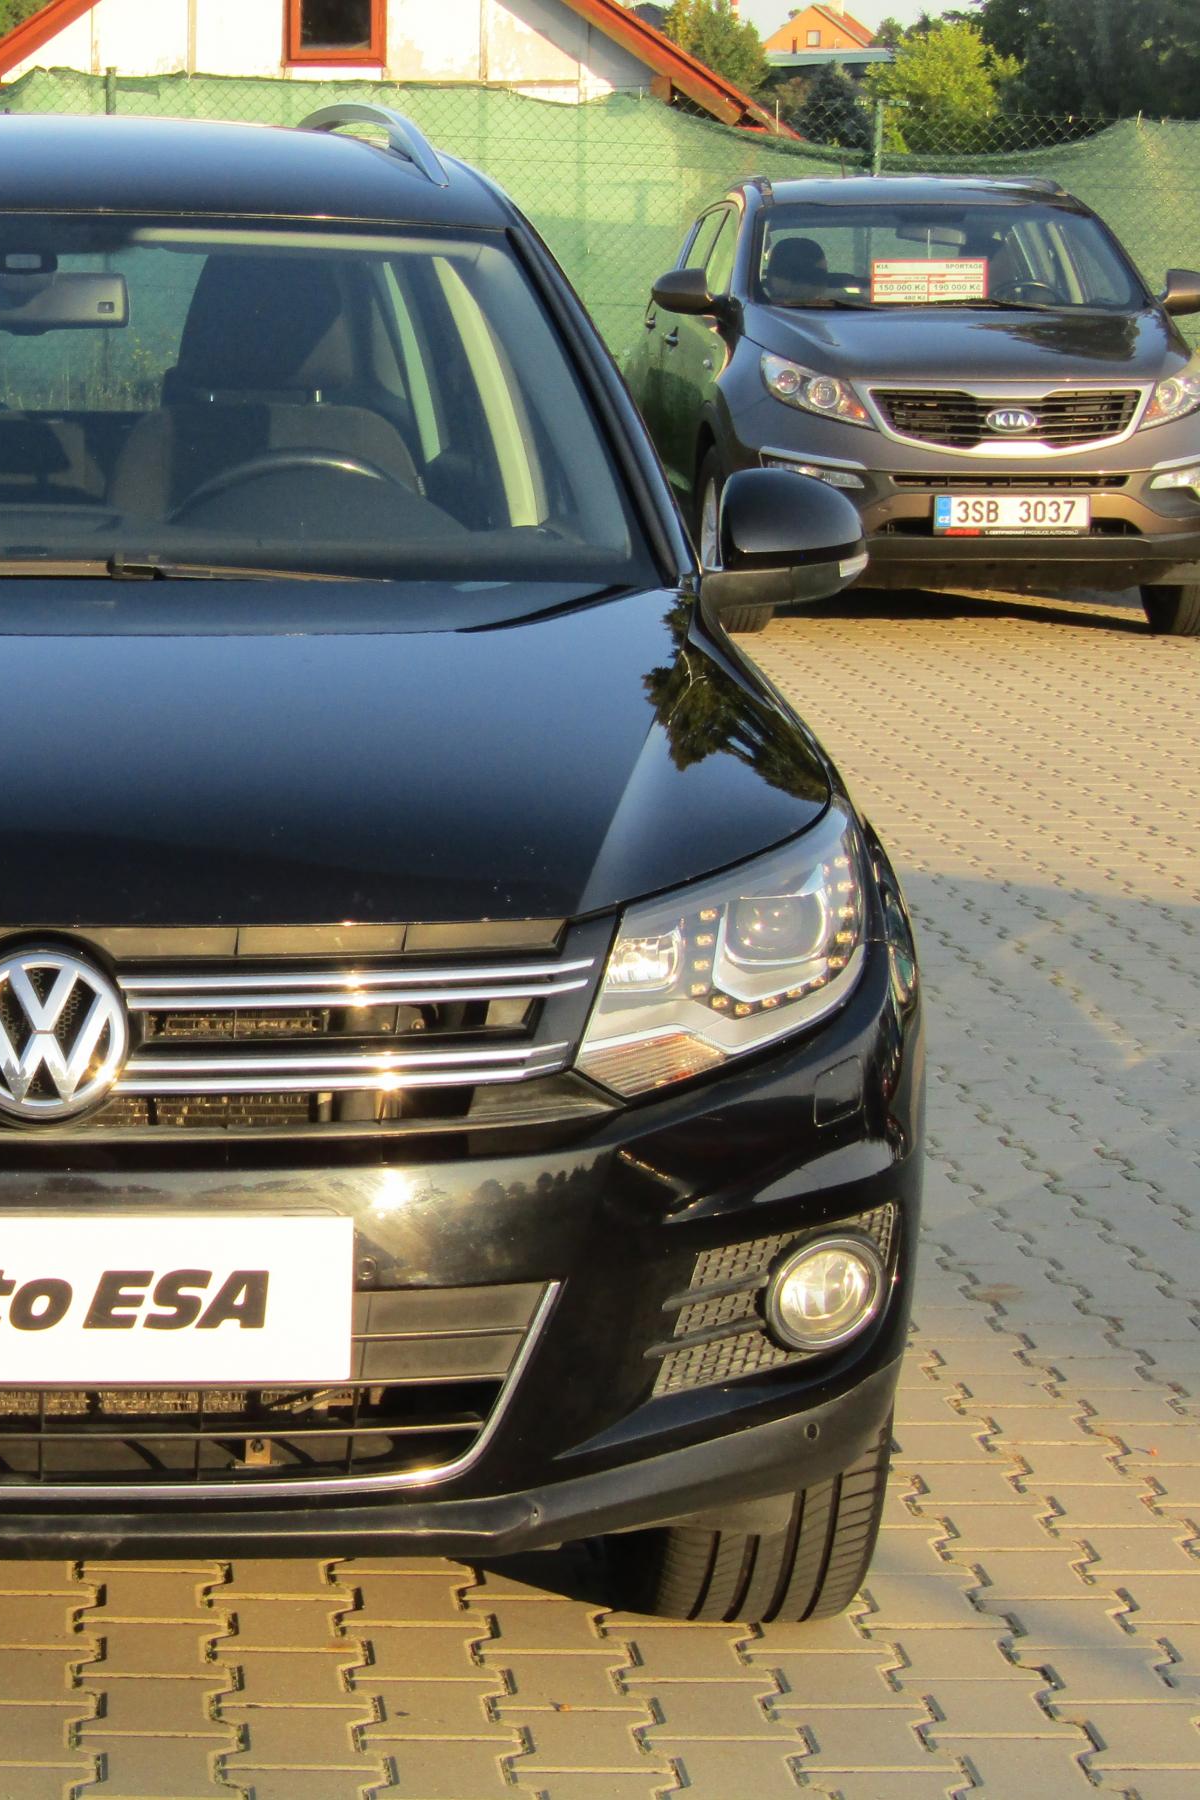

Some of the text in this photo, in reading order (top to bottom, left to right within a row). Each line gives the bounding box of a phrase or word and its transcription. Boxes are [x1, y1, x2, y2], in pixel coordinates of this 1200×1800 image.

[995, 413, 1029, 427] KIA
[957, 500, 1076, 523] 3SB 3037
[82, 1269, 270, 1330] ESA
